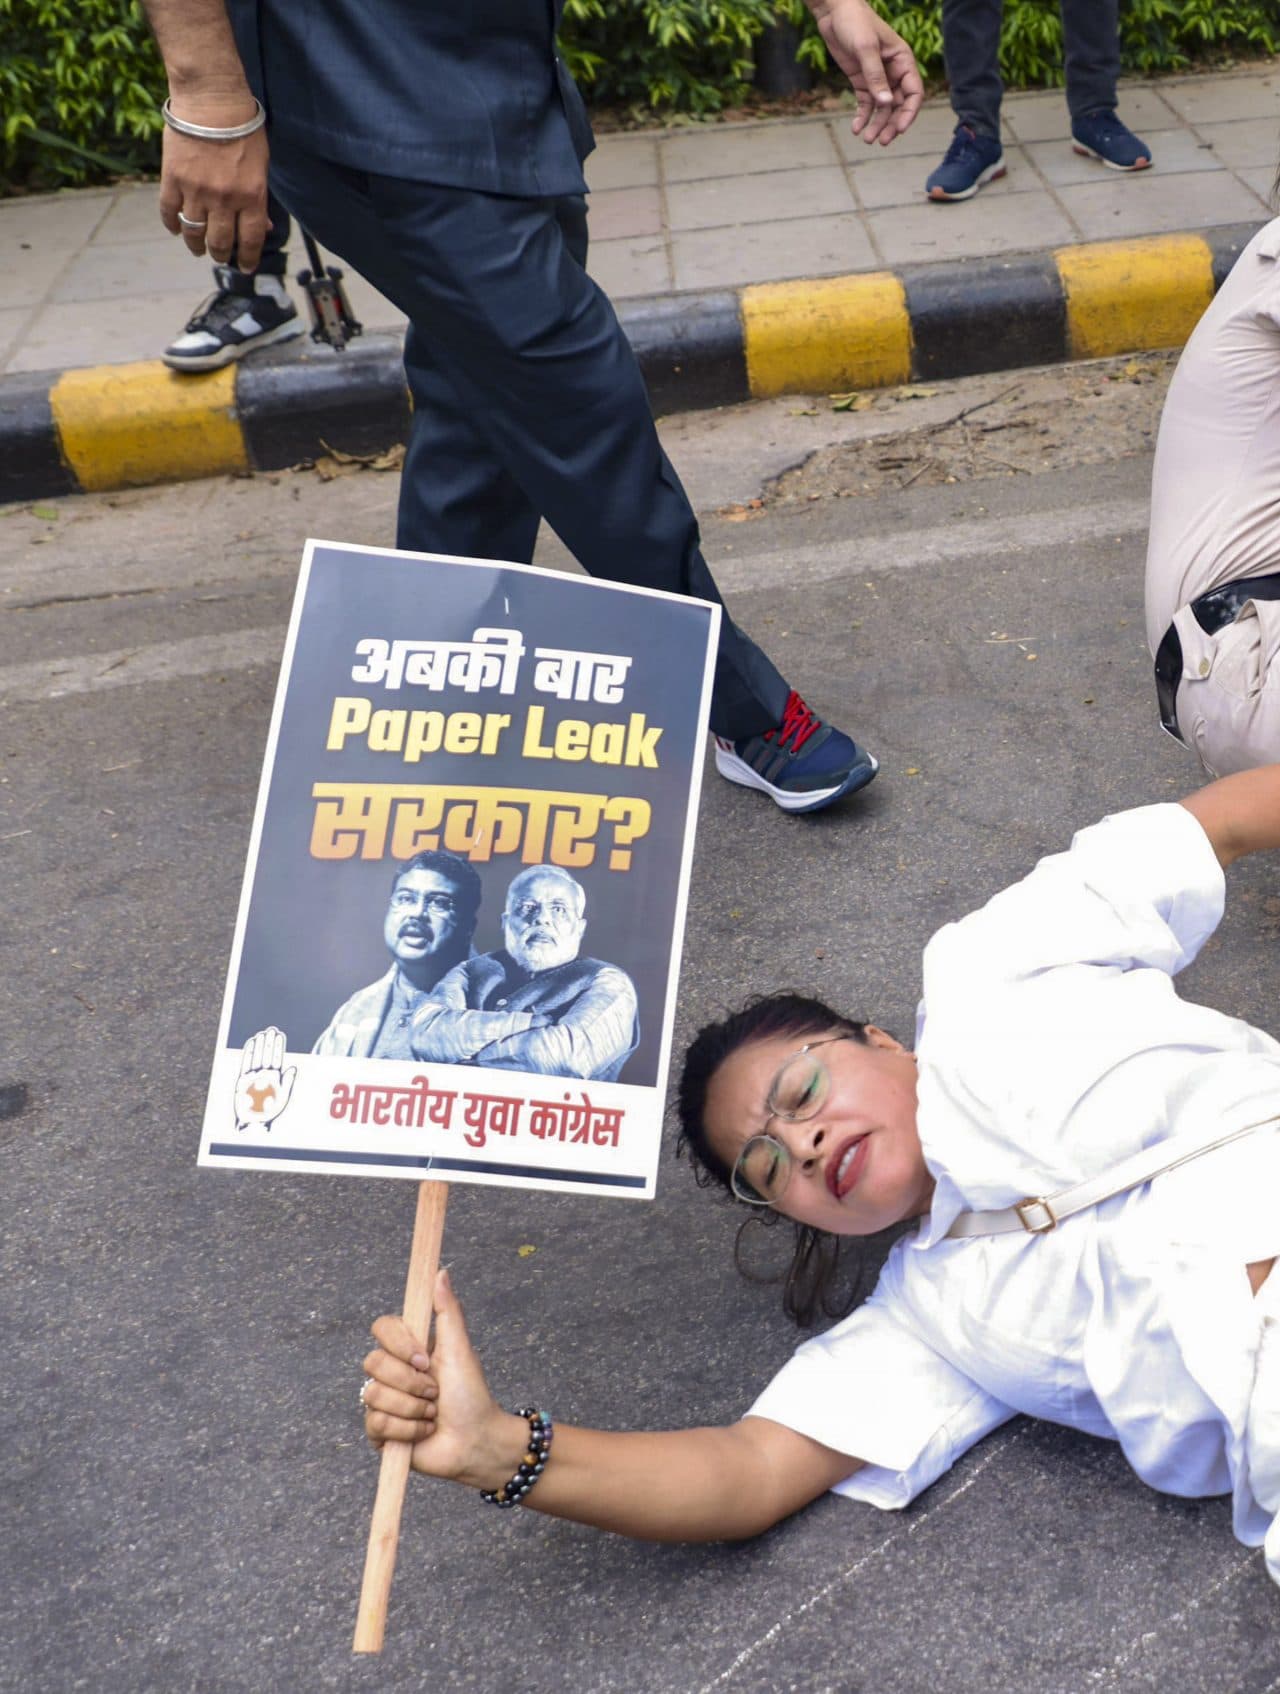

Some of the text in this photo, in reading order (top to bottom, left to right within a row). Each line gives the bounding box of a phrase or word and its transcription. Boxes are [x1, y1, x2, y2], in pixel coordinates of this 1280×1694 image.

[351, 627, 633, 704] अबकी बार
[326, 696, 664, 768] Paper Leak
[310, 782, 652, 871] सरकार?
[329, 1075, 626, 1148] भारतीय युवा कांग्रेस
